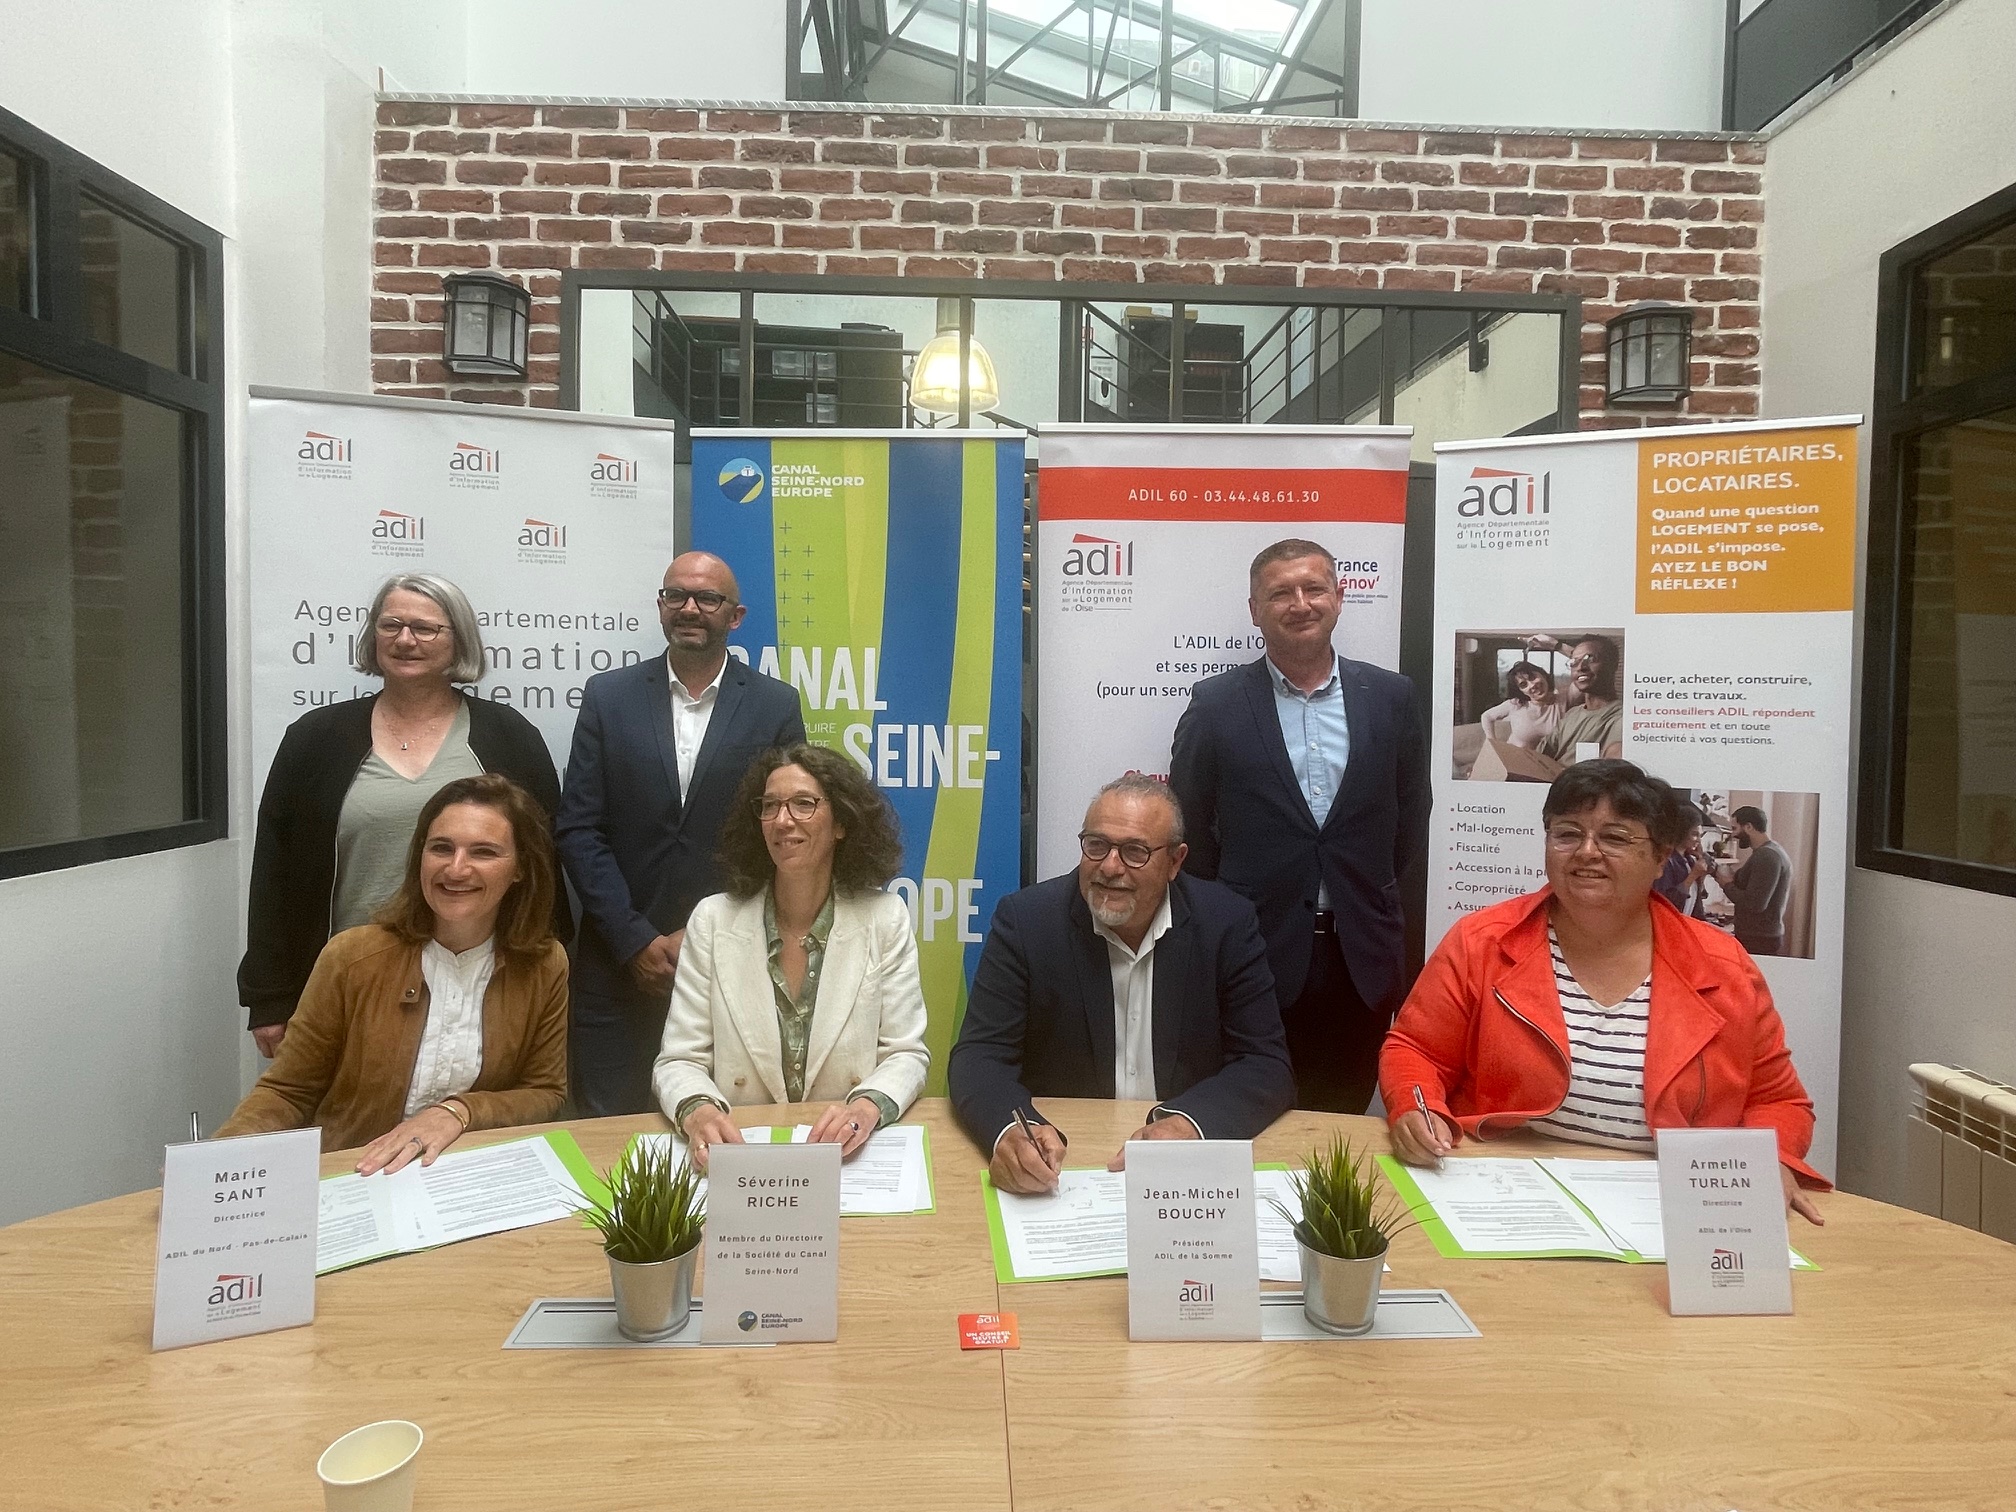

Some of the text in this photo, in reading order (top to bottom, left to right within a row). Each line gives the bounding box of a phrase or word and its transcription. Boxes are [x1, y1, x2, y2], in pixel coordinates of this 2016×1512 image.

[298, 438, 351, 462] adil
[1653, 444, 1843, 468] PROPRIÉTAIRES,
[450, 450, 499, 472] adil
[590, 461, 638, 482] adil
[771, 464, 820, 475] CANAL
[771, 476, 865, 486] SEINE-NORD
[1653, 472, 1800, 494] LOCATAIRES.
[771, 487, 833, 498] EUROPE
[1128, 489, 1163, 502] ADIL
[1169, 490, 1188, 502] 60
[1204, 490, 1320, 503] 03.44.48.61.30
[1458, 471, 1550, 517] adil
[1652, 504, 1820, 522] Quand une question
[372, 517, 424, 540] adil
[1457, 520, 1550, 530] Agence Départementale
[1652, 522, 1824, 536] LOGEMENT se pose,
[518, 525, 566, 548] adil
[1456, 529, 1550, 540] d'Information
[1480, 538, 1549, 550] Logement
[1651, 542, 1786, 556] l'ADIL s'impose.
[1062, 540, 1133, 576] adil
[1334, 558, 1378, 572] rance
[1650, 560, 1768, 574] AYEZ LE BON
[1339, 574, 1380, 590] énov'
[1650, 577, 1728, 590] RÉFLEXE
[1080, 595, 1132, 604] Logement
[294, 599, 640, 632] Agen artementale
[1173, 635, 1266, 650] L'ADIL de l'O
[292, 632, 641, 671] d'Imation
[1156, 660, 1239, 676] et ses perm
[726, 645, 888, 711] NAL
[1634, 674, 1812, 686] Louer, acheter, construire,
[1096, 681, 1192, 698] (pour un serv
[1633, 689, 1747, 700] faire des travaux.
[293, 689, 338, 706] sur
[1633, 706, 1816, 719] Les conseillers ADIL répondent
[1632, 720, 1706, 730] gratuitement
[1710, 722, 1721, 730] et
[1741, 722, 1771, 730] toute
[1632, 734, 1775, 746] objectivité à vos questions.
[843, 723, 1001, 788] SEINE-
[1457, 802, 1506, 814] Location
[1456, 822, 1535, 836] Mal-logement
[1456, 842, 1500, 854] Fiscalité
[1455, 862, 1512, 874] Accession
[1514, 865, 1521, 875] à
[1524, 865, 1532, 876] la
[1454, 881, 1526, 895] Copropriété
[887, 877, 983, 943] OPE
[1690, 1159, 1747, 1170] Armelle
[214, 1167, 268, 1184] Marie
[737, 1175, 810, 1188] Séverine
[1689, 1178, 1750, 1188] TURLAN
[214, 1186, 266, 1204] SANT
[1143, 1188, 1240, 1200] Jean-Michel
[747, 1196, 799, 1208] RICHE
[214, 1210, 266, 1223] Directrice
[1158, 1208, 1227, 1220] BOUCHY
[775, 1234, 824, 1242] Directoire
[165, 1251, 189, 1259] ADIL
[192, 1248, 205, 1256] du
[208, 1244, 232, 1253] Nord
[242, 1234, 308, 1248] Pas-de-Calais
[745, 1251, 781, 1259] Société
[800, 1250, 828, 1258] Canal
[1154, 1252, 1233, 1260] ADIL de la Somme
[745, 1267, 799, 1275] Seine-Nord
[208, 1273, 262, 1305] adil
[1180, 1283, 1214, 1302] adil
[976, 1315, 1000, 1324] adil
